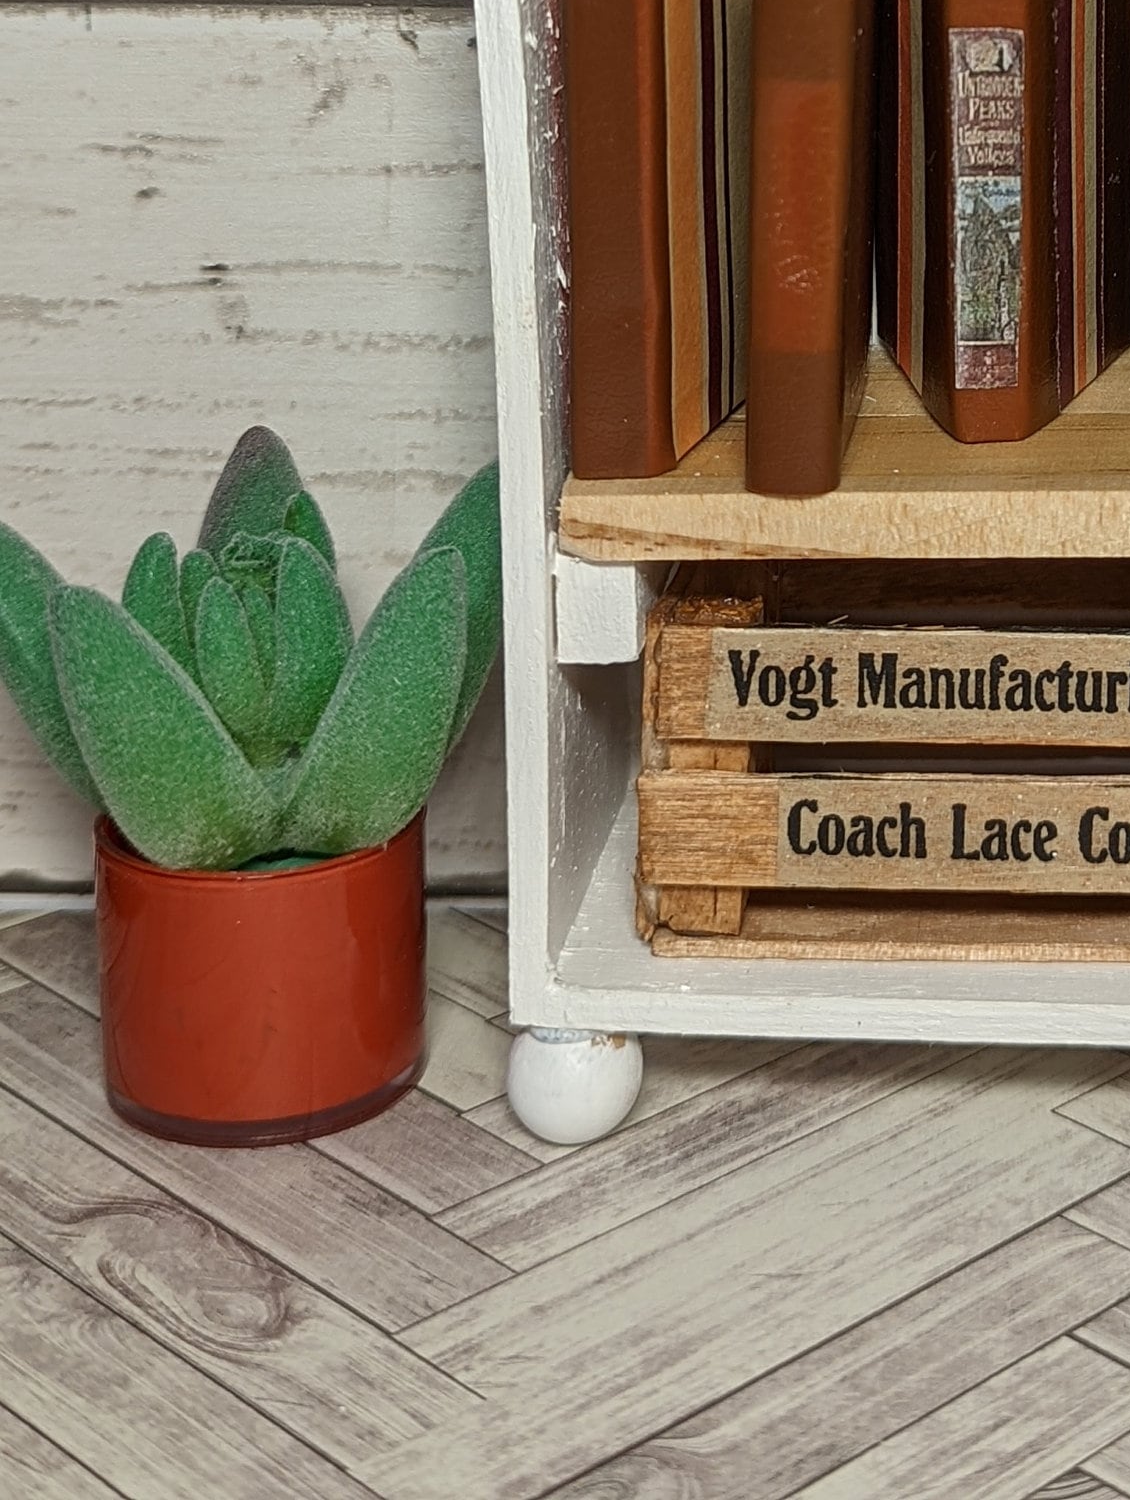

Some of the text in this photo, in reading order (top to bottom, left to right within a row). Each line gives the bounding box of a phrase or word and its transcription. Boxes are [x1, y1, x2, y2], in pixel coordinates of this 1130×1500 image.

[967, 98, 1015, 121] PEAKS
[728, 650, 838, 720] Vogt
[788, 799, 927, 858] Coach
[951, 804, 1057, 862] Lace
